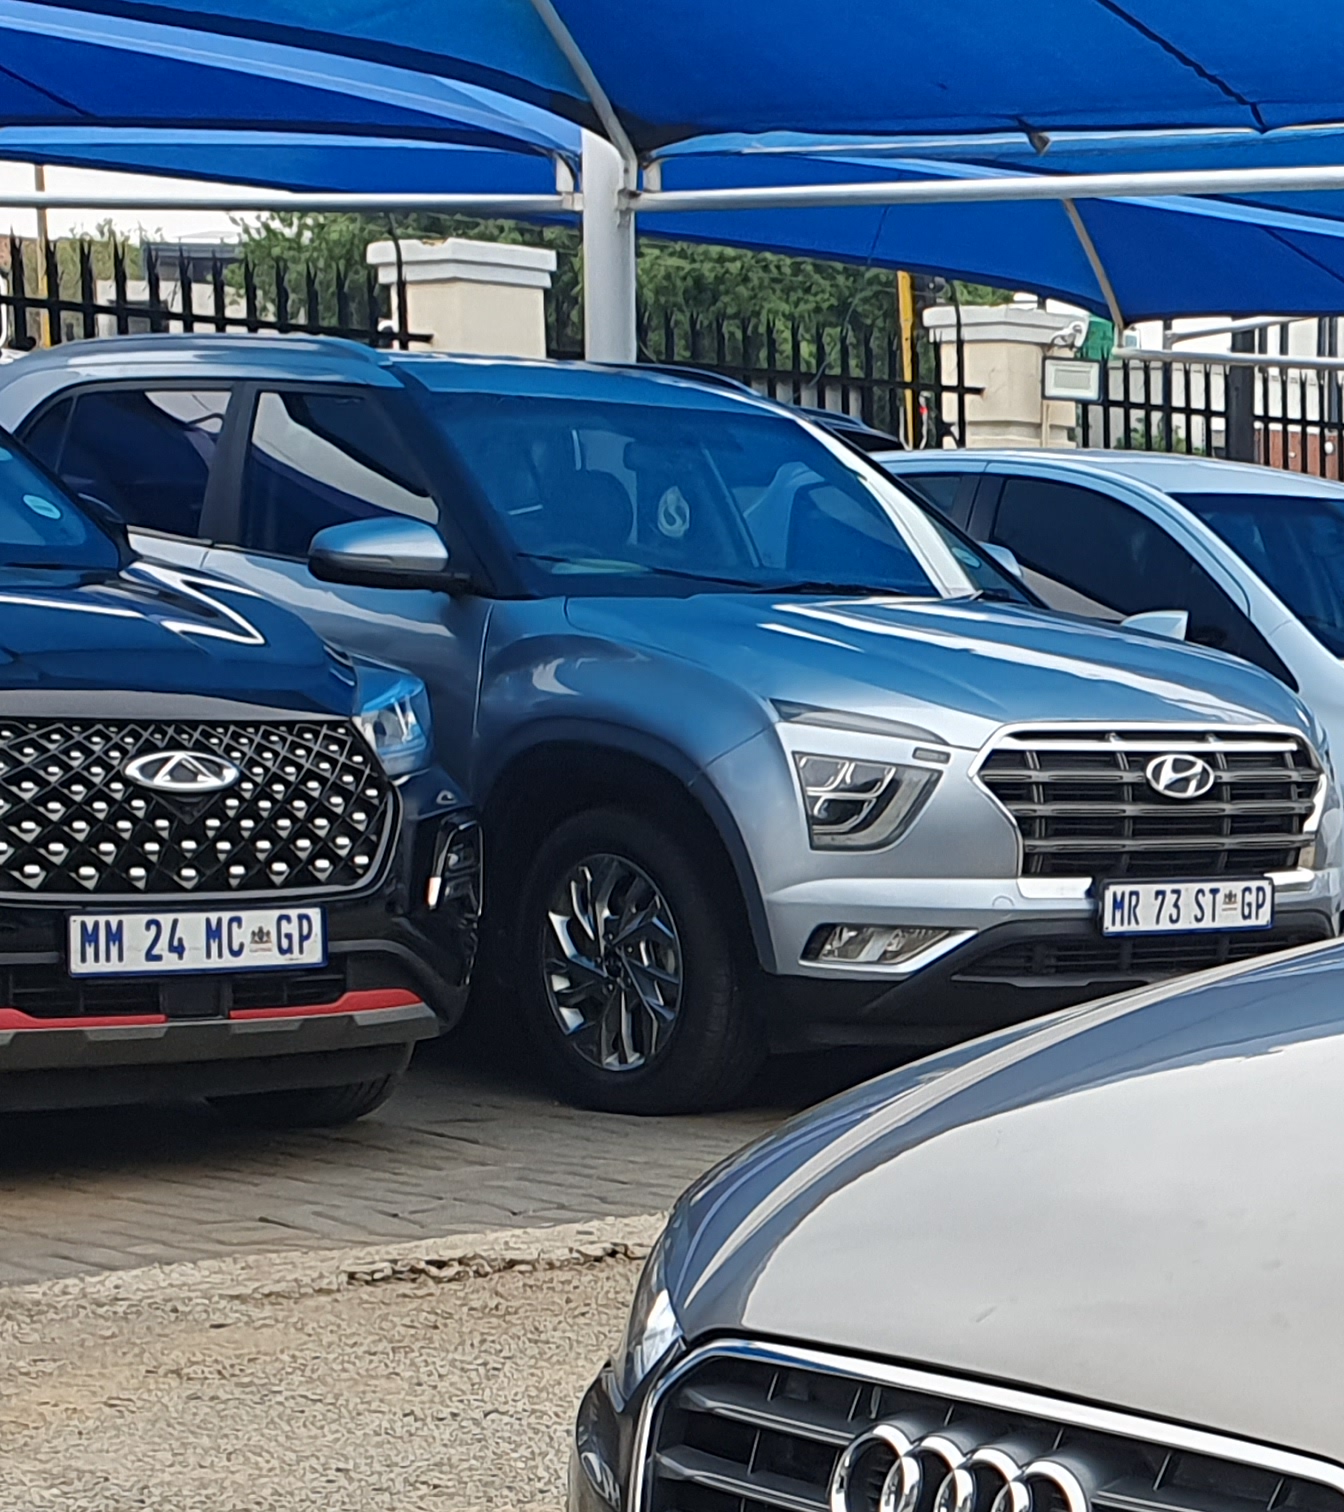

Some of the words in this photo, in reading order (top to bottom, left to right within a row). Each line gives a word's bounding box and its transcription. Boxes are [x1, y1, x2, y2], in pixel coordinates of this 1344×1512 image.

[1111, 889, 1140, 927] MR
[1154, 888, 1182, 925] 73
[1194, 887, 1221, 924] ST
[1241, 885, 1267, 921] GP
[79, 918, 125, 964] MM
[144, 917, 186, 963] 24
[205, 914, 245, 960] MC
[275, 912, 314, 957] GP
